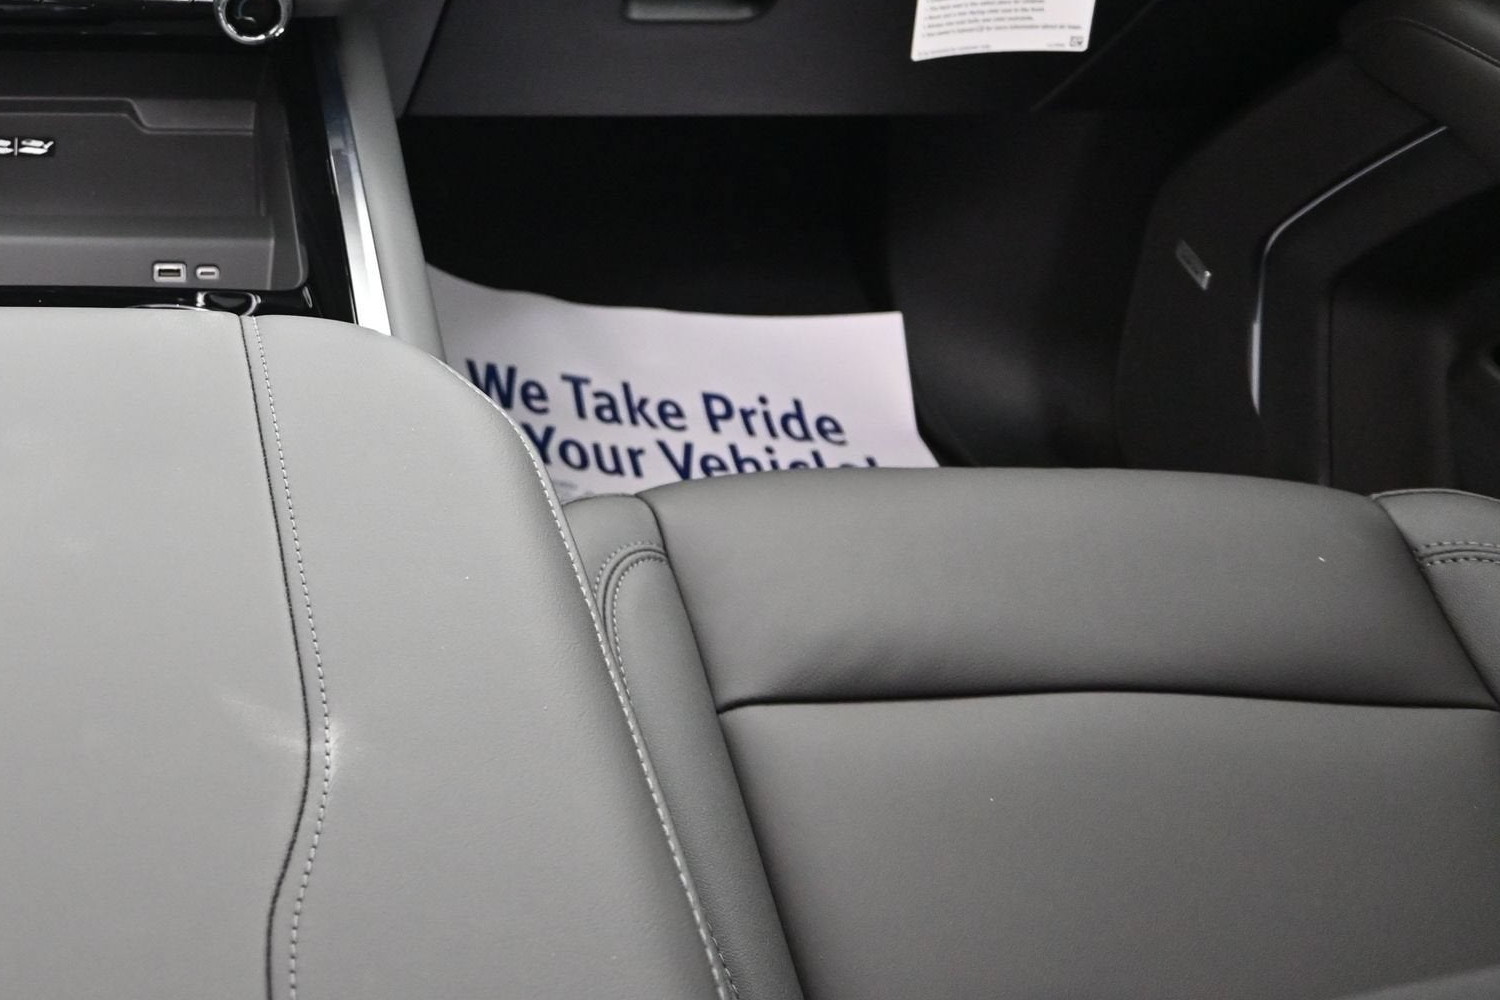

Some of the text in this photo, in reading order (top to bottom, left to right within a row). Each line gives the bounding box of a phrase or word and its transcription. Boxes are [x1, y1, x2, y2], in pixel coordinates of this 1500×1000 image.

[465, 358, 849, 446] We Take Pride
[521, 422, 646, 479] Your
